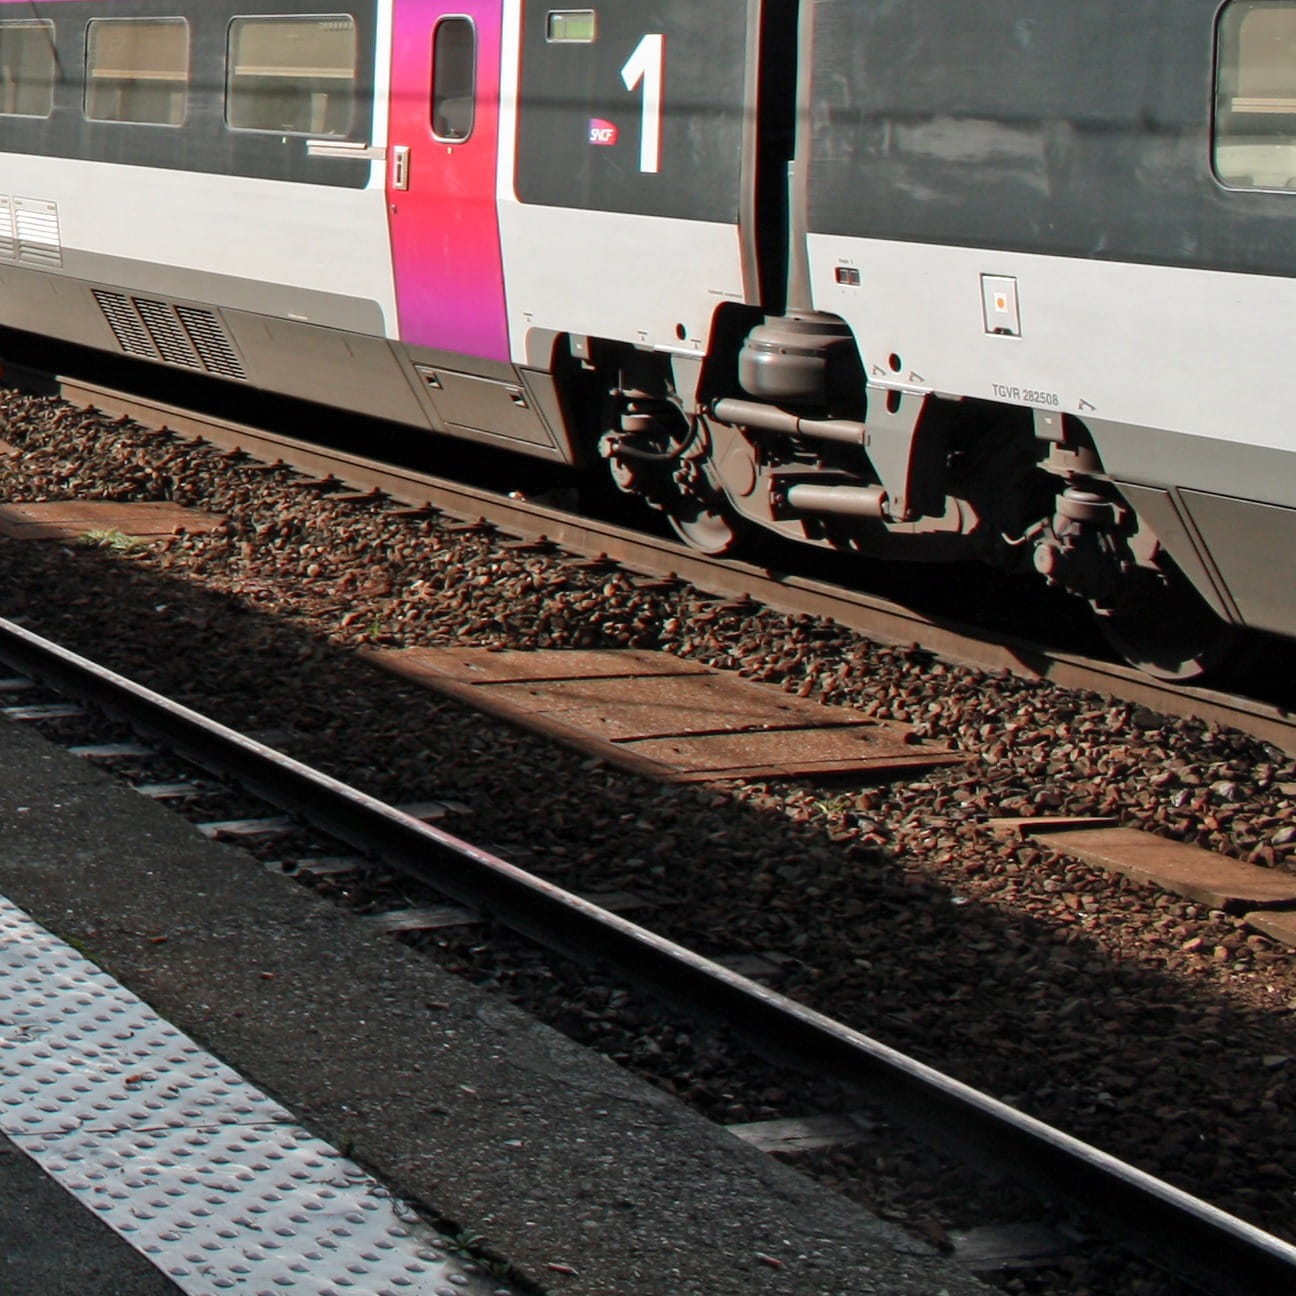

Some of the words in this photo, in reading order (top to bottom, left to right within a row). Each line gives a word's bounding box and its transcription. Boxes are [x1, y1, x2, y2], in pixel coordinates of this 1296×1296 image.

[620, 33, 665, 174] 1
[589, 128, 614, 141] SNCF
[992, 384, 1021, 401] TGVR
